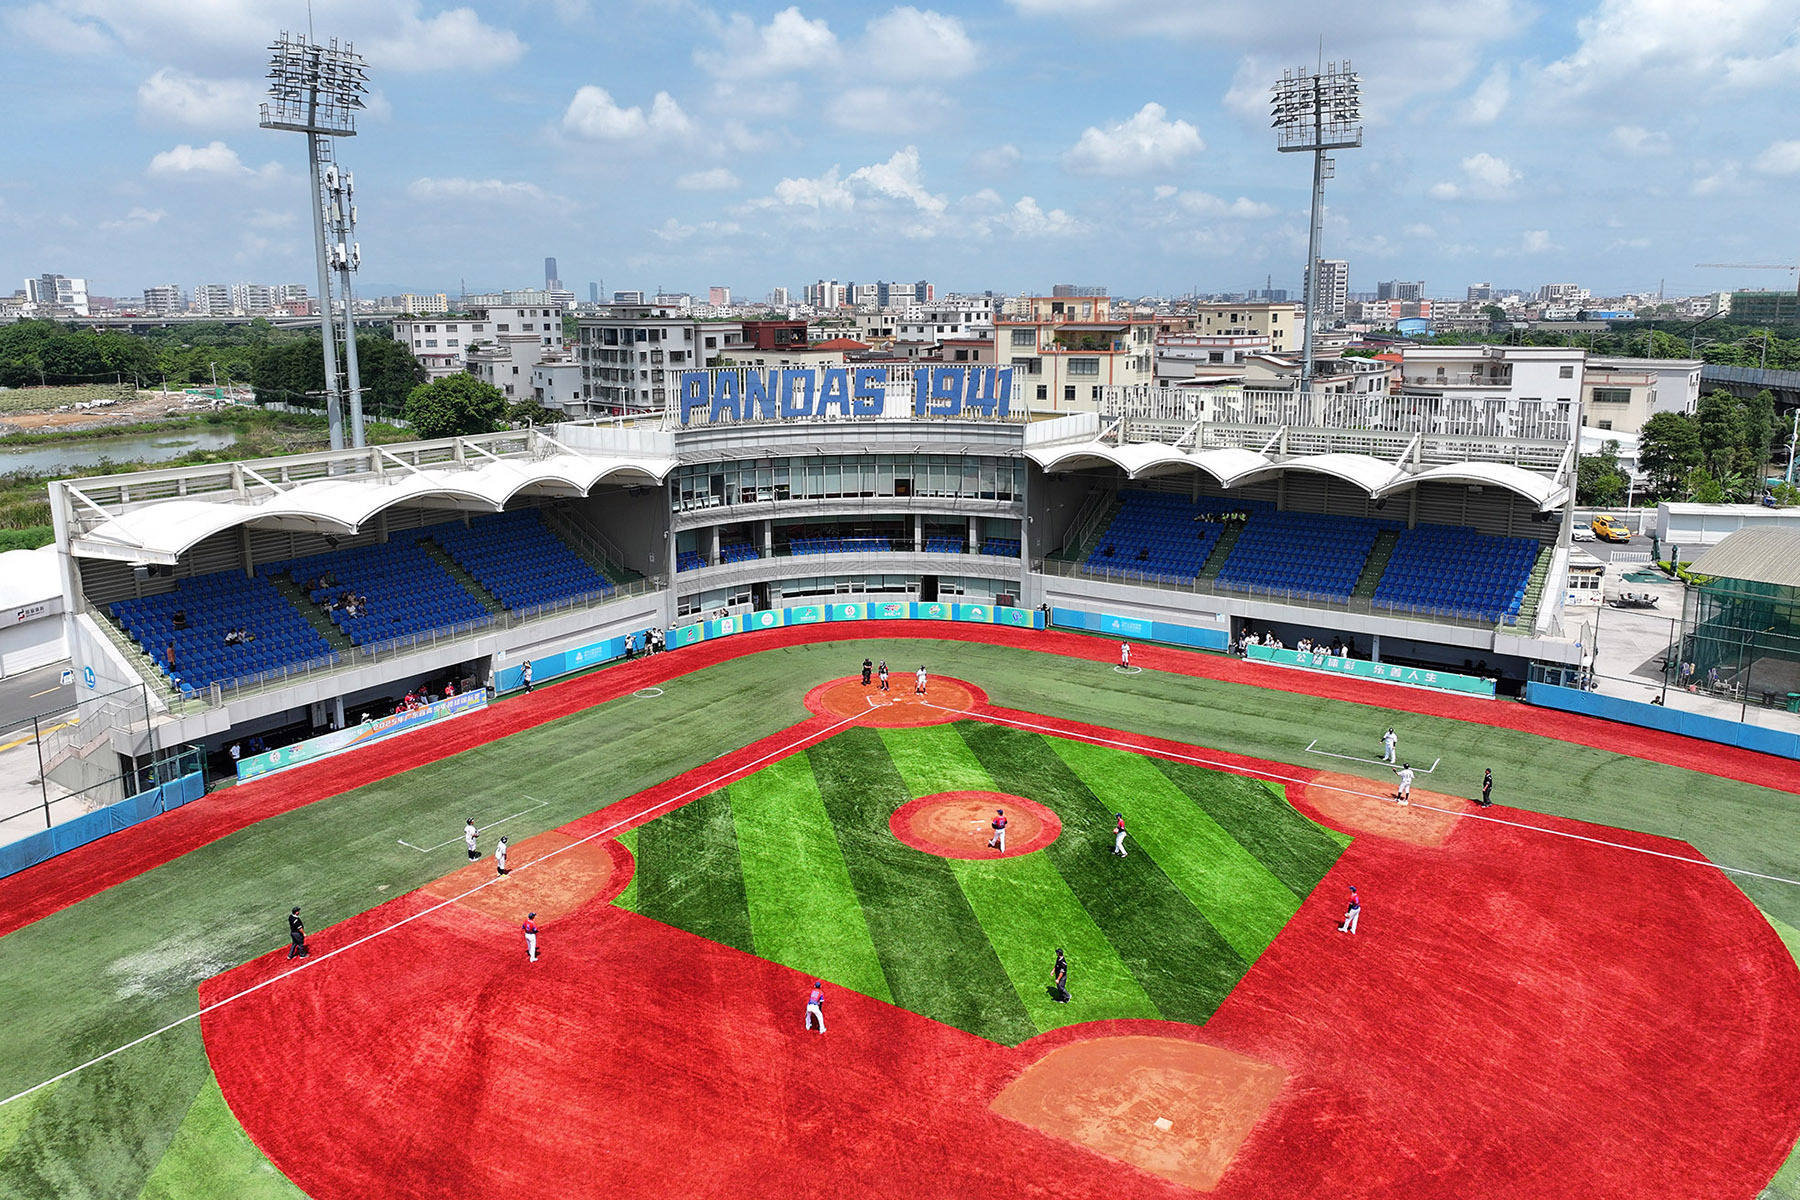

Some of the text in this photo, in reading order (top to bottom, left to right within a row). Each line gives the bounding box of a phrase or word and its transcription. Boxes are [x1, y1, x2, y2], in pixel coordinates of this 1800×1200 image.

[681, 367, 1012, 424] PANDAS 1941
[1374, 664, 1437, 683] 乐善人生
